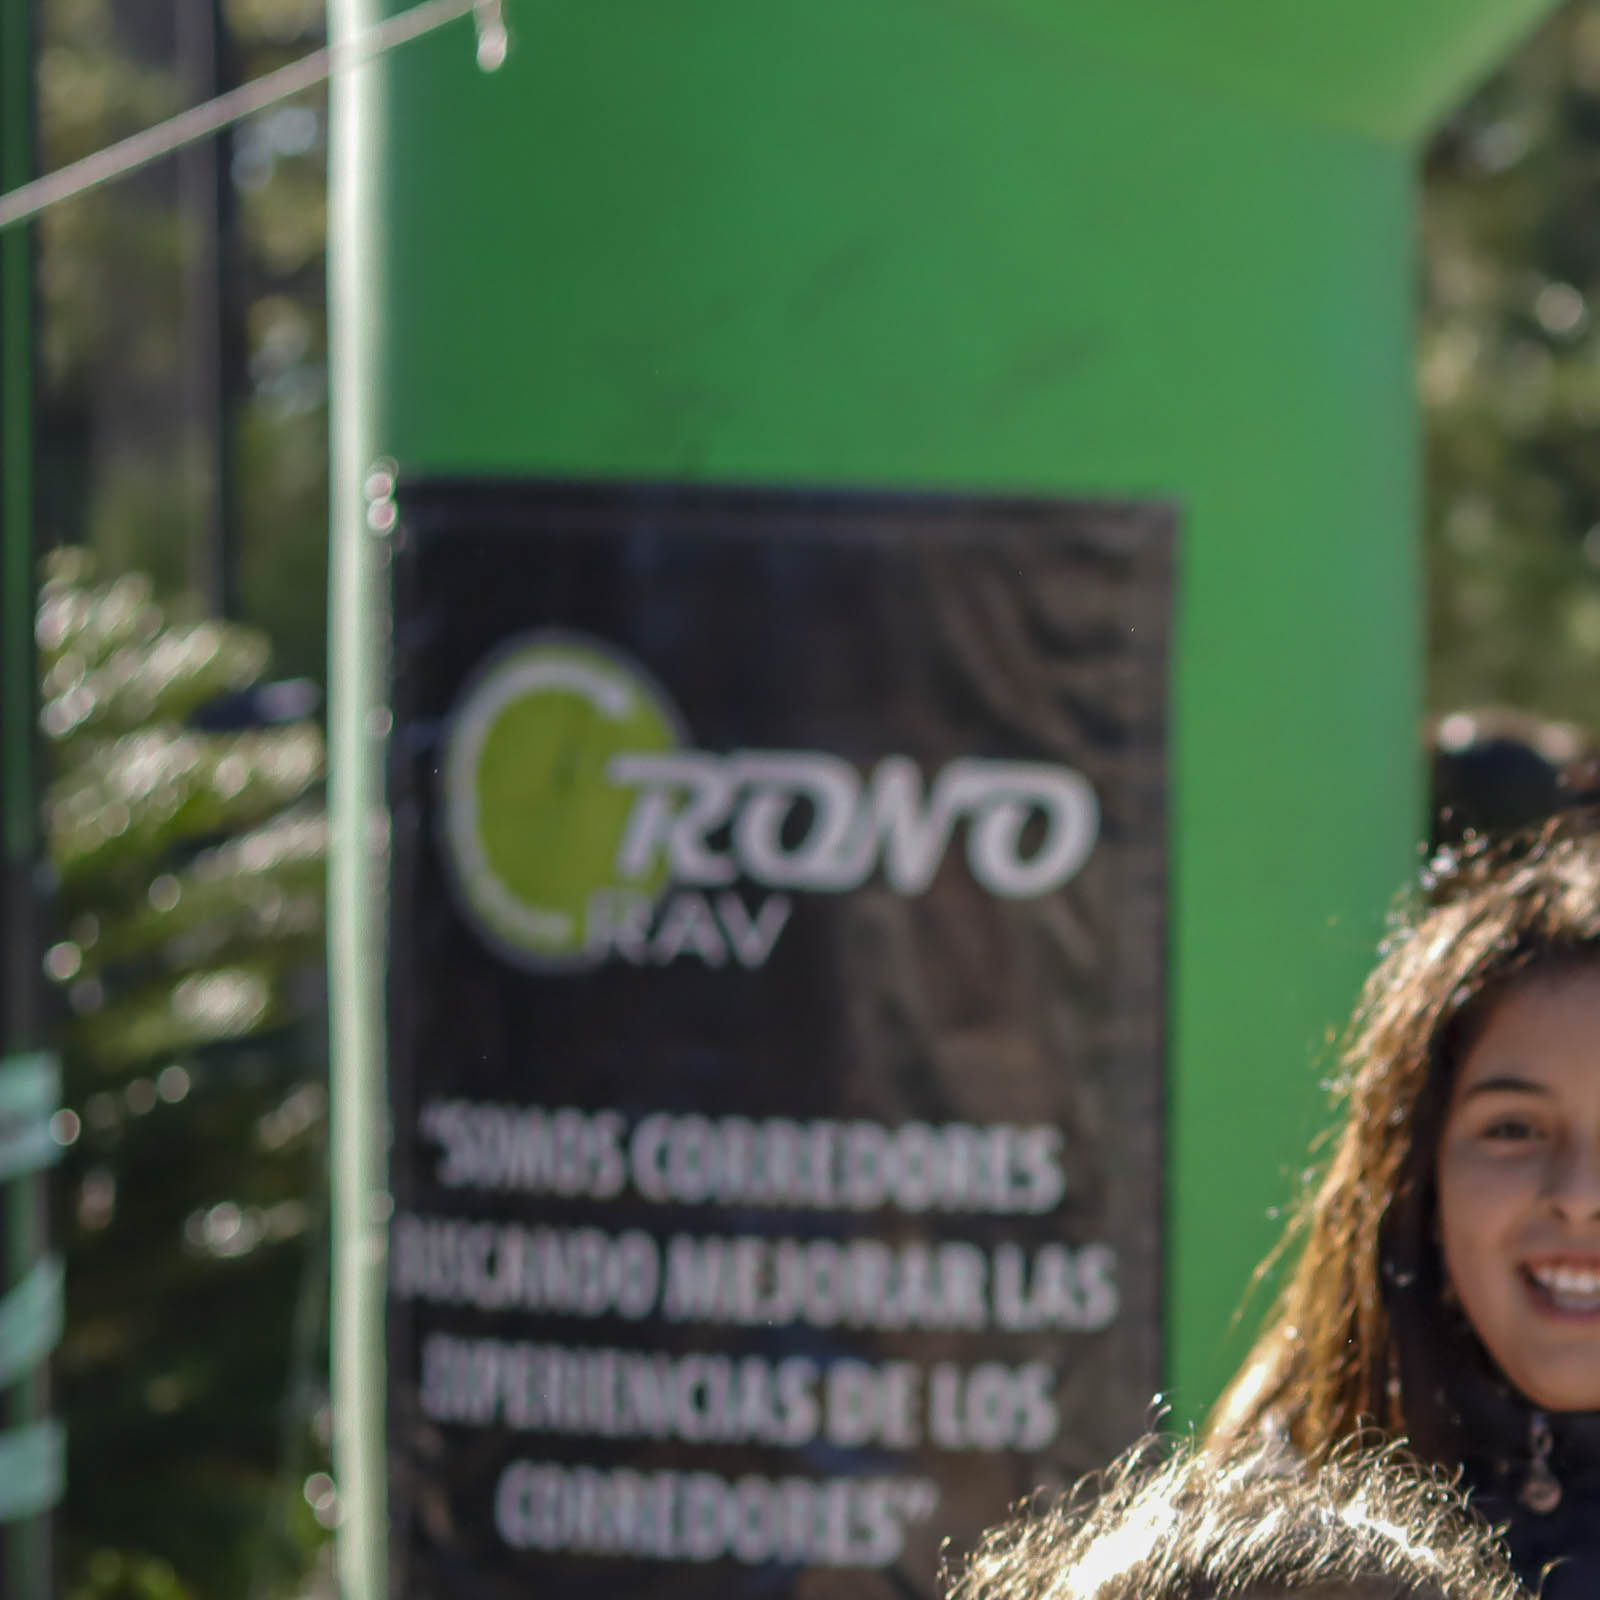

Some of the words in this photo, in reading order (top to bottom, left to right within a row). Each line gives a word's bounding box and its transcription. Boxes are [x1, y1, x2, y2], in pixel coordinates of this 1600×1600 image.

[587, 888, 792, 967] RAV
[630, 1112, 1066, 1213] CORREDORES
[663, 1231, 991, 1328] MEJORAR
[995, 1245, 1120, 1331] LAS
[827, 1359, 924, 1448] DE
[930, 1361, 1059, 1452] LOS
